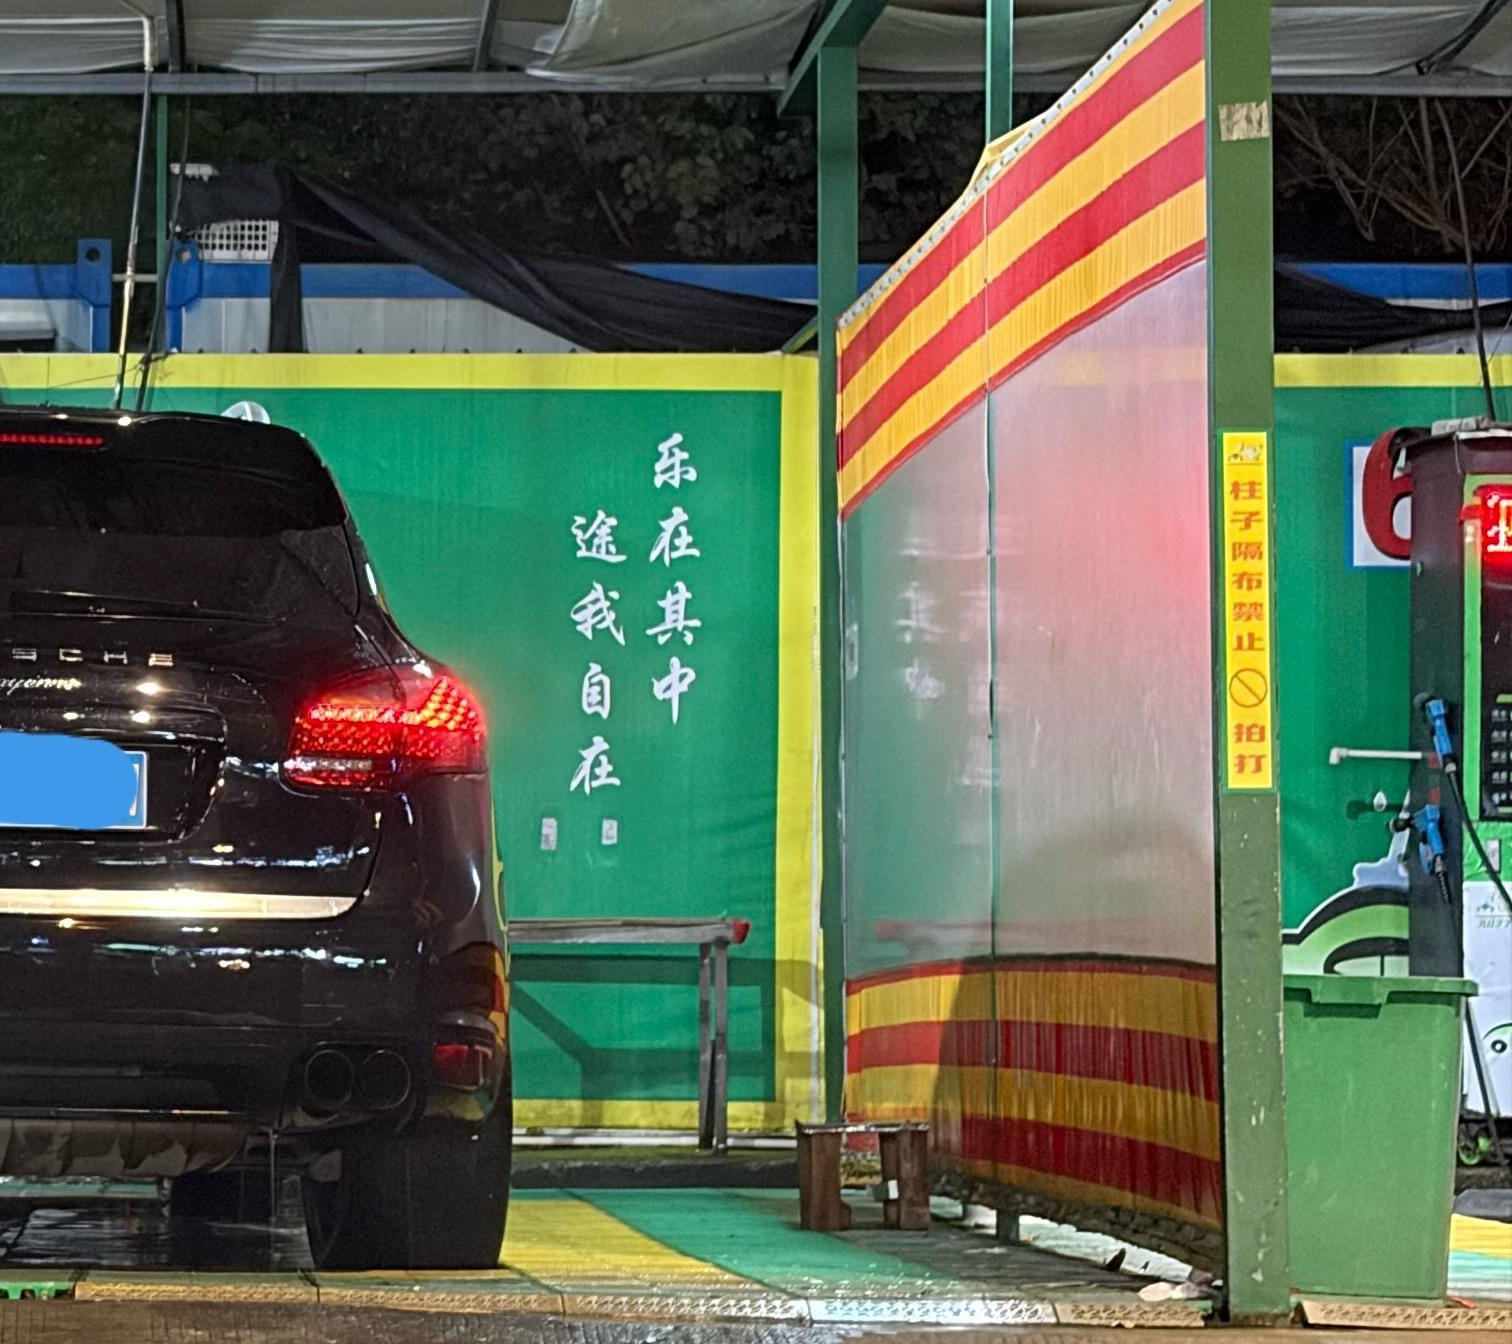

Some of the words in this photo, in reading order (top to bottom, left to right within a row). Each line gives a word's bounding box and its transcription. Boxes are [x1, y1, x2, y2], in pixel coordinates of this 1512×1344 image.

[570, 510, 628, 796] 途我自在
[645, 432, 701, 725] 乐在其中
